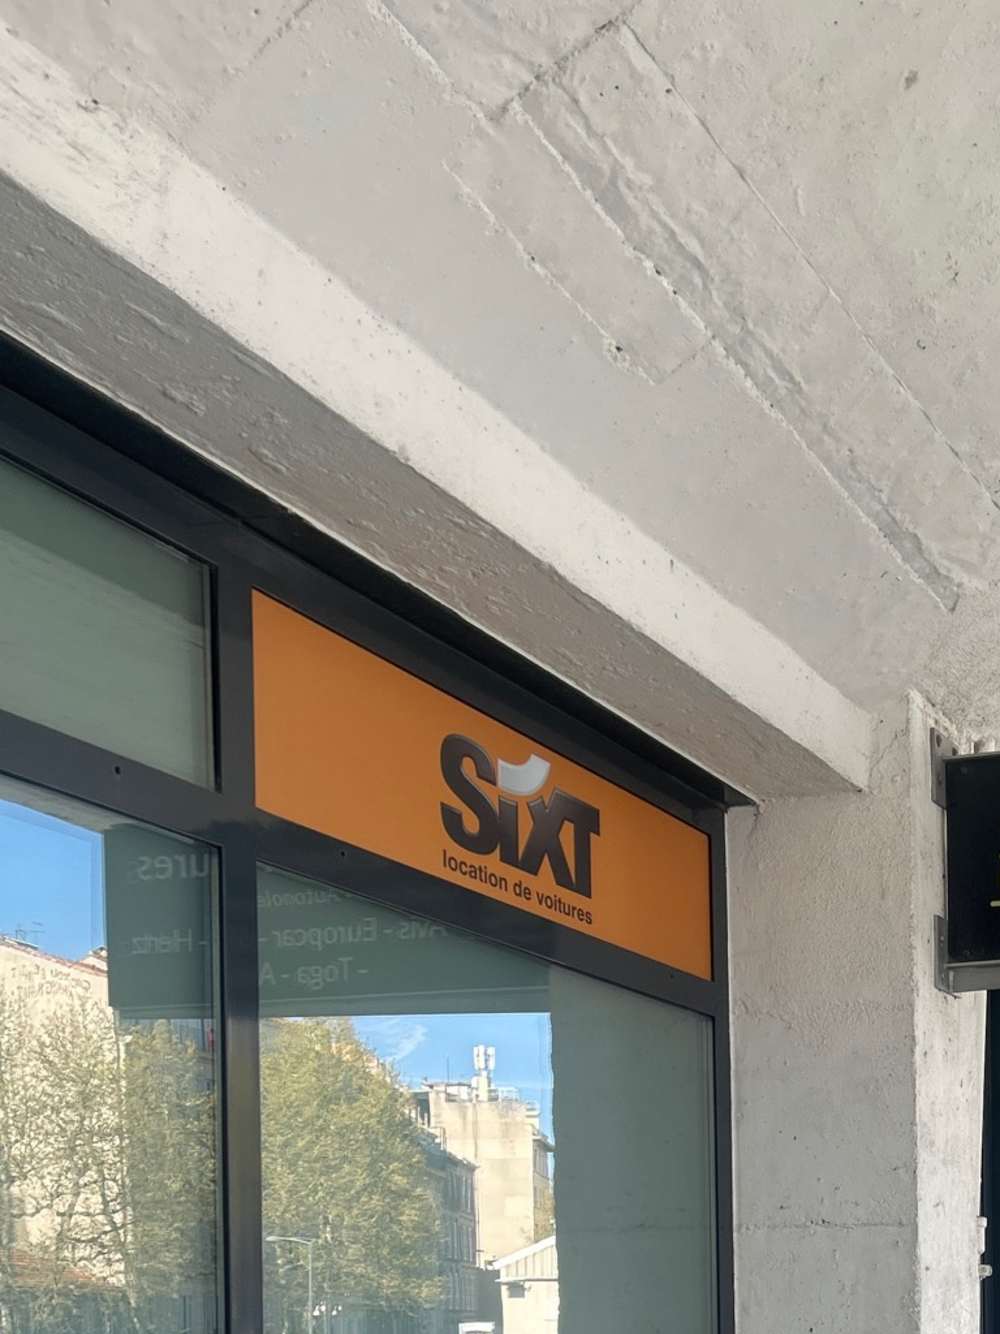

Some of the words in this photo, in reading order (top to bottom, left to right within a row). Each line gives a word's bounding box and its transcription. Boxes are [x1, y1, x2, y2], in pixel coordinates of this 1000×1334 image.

[442, 849, 509, 893] location
[512, 879, 532, 901] de
[535, 889, 593, 925] voitures
